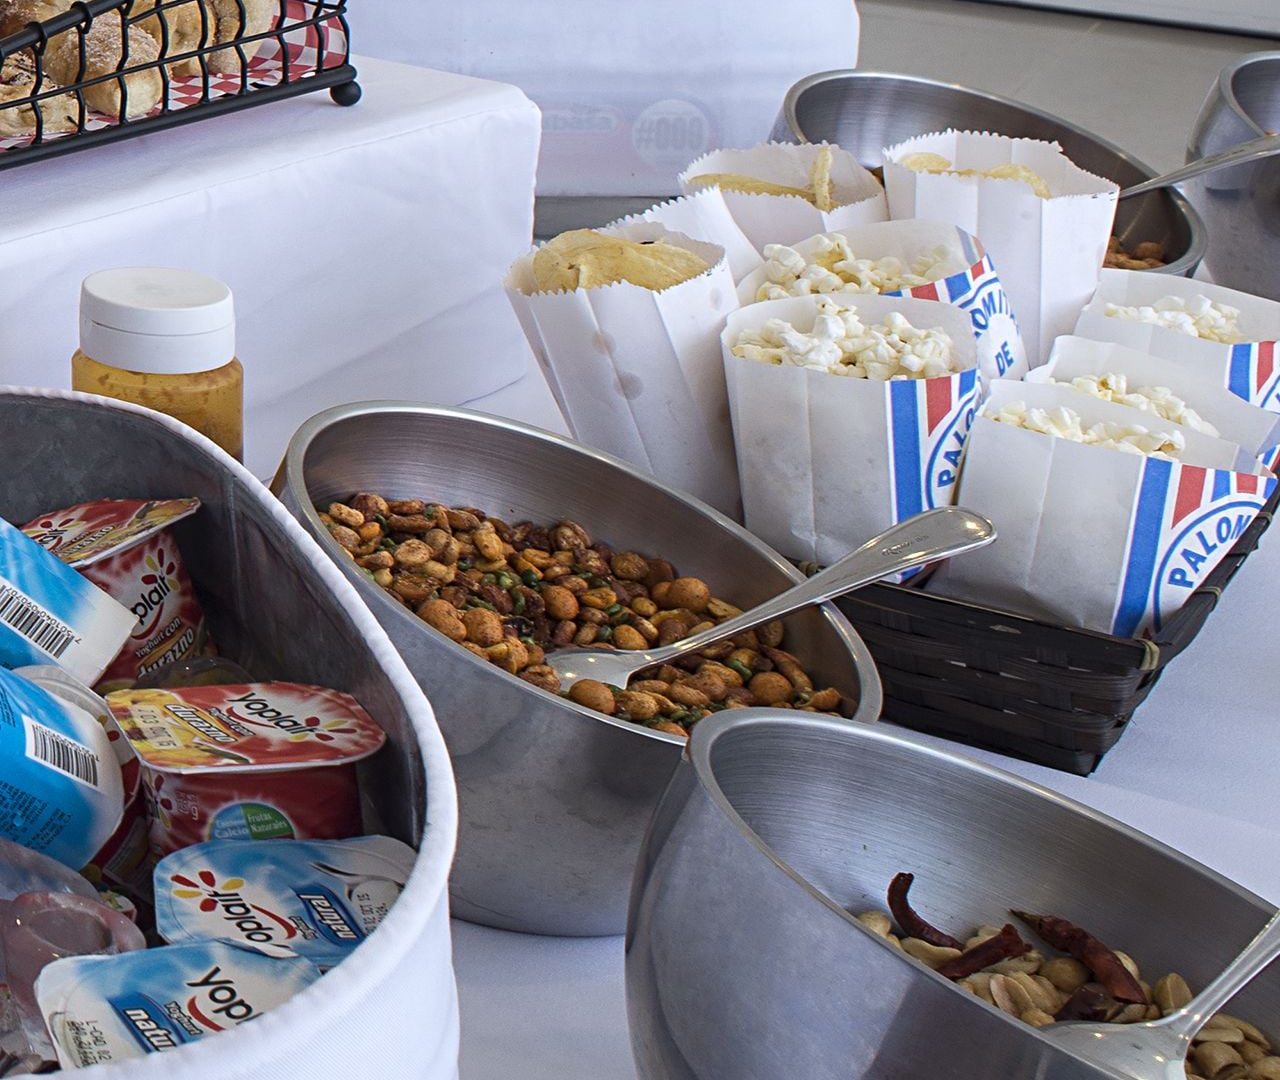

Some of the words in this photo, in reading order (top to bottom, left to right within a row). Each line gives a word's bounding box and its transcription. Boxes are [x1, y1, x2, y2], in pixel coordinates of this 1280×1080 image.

[131, 575, 171, 626] plait
[164, 703, 239, 744] durazno
[123, 1007, 177, 1052] natu
